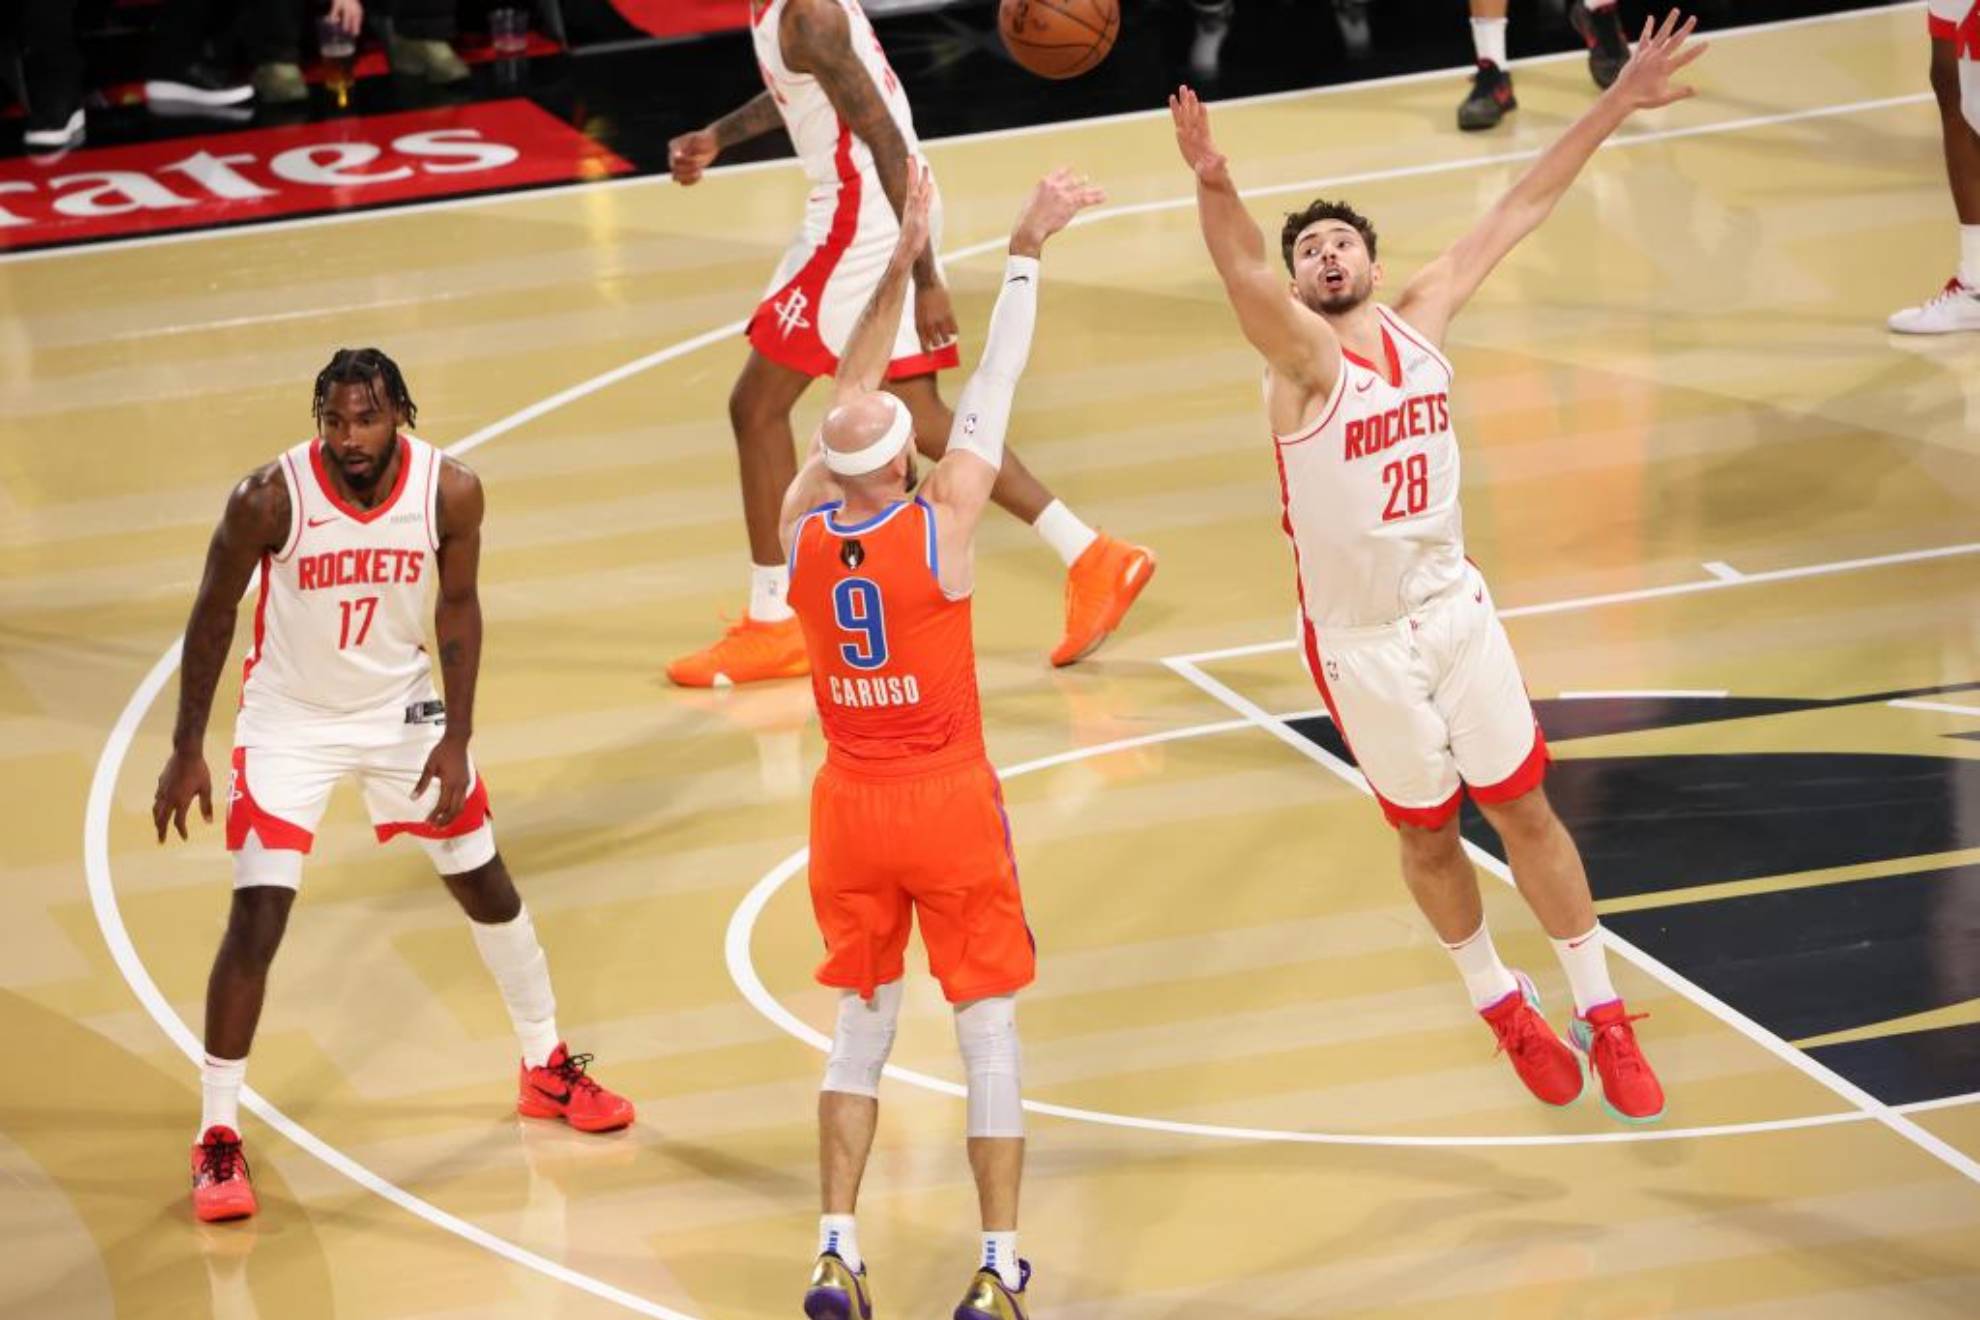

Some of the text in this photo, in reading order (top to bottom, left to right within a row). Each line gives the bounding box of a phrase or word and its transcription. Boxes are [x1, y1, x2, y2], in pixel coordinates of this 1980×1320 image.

[1345, 393, 1449, 461] ROCKETS
[1382, 454, 1428, 521] 28
[299, 549, 424, 590] ROCKETS
[339, 597, 378, 649] 17
[832, 576, 889, 670] 9
[829, 675, 920, 707] CARUSO
